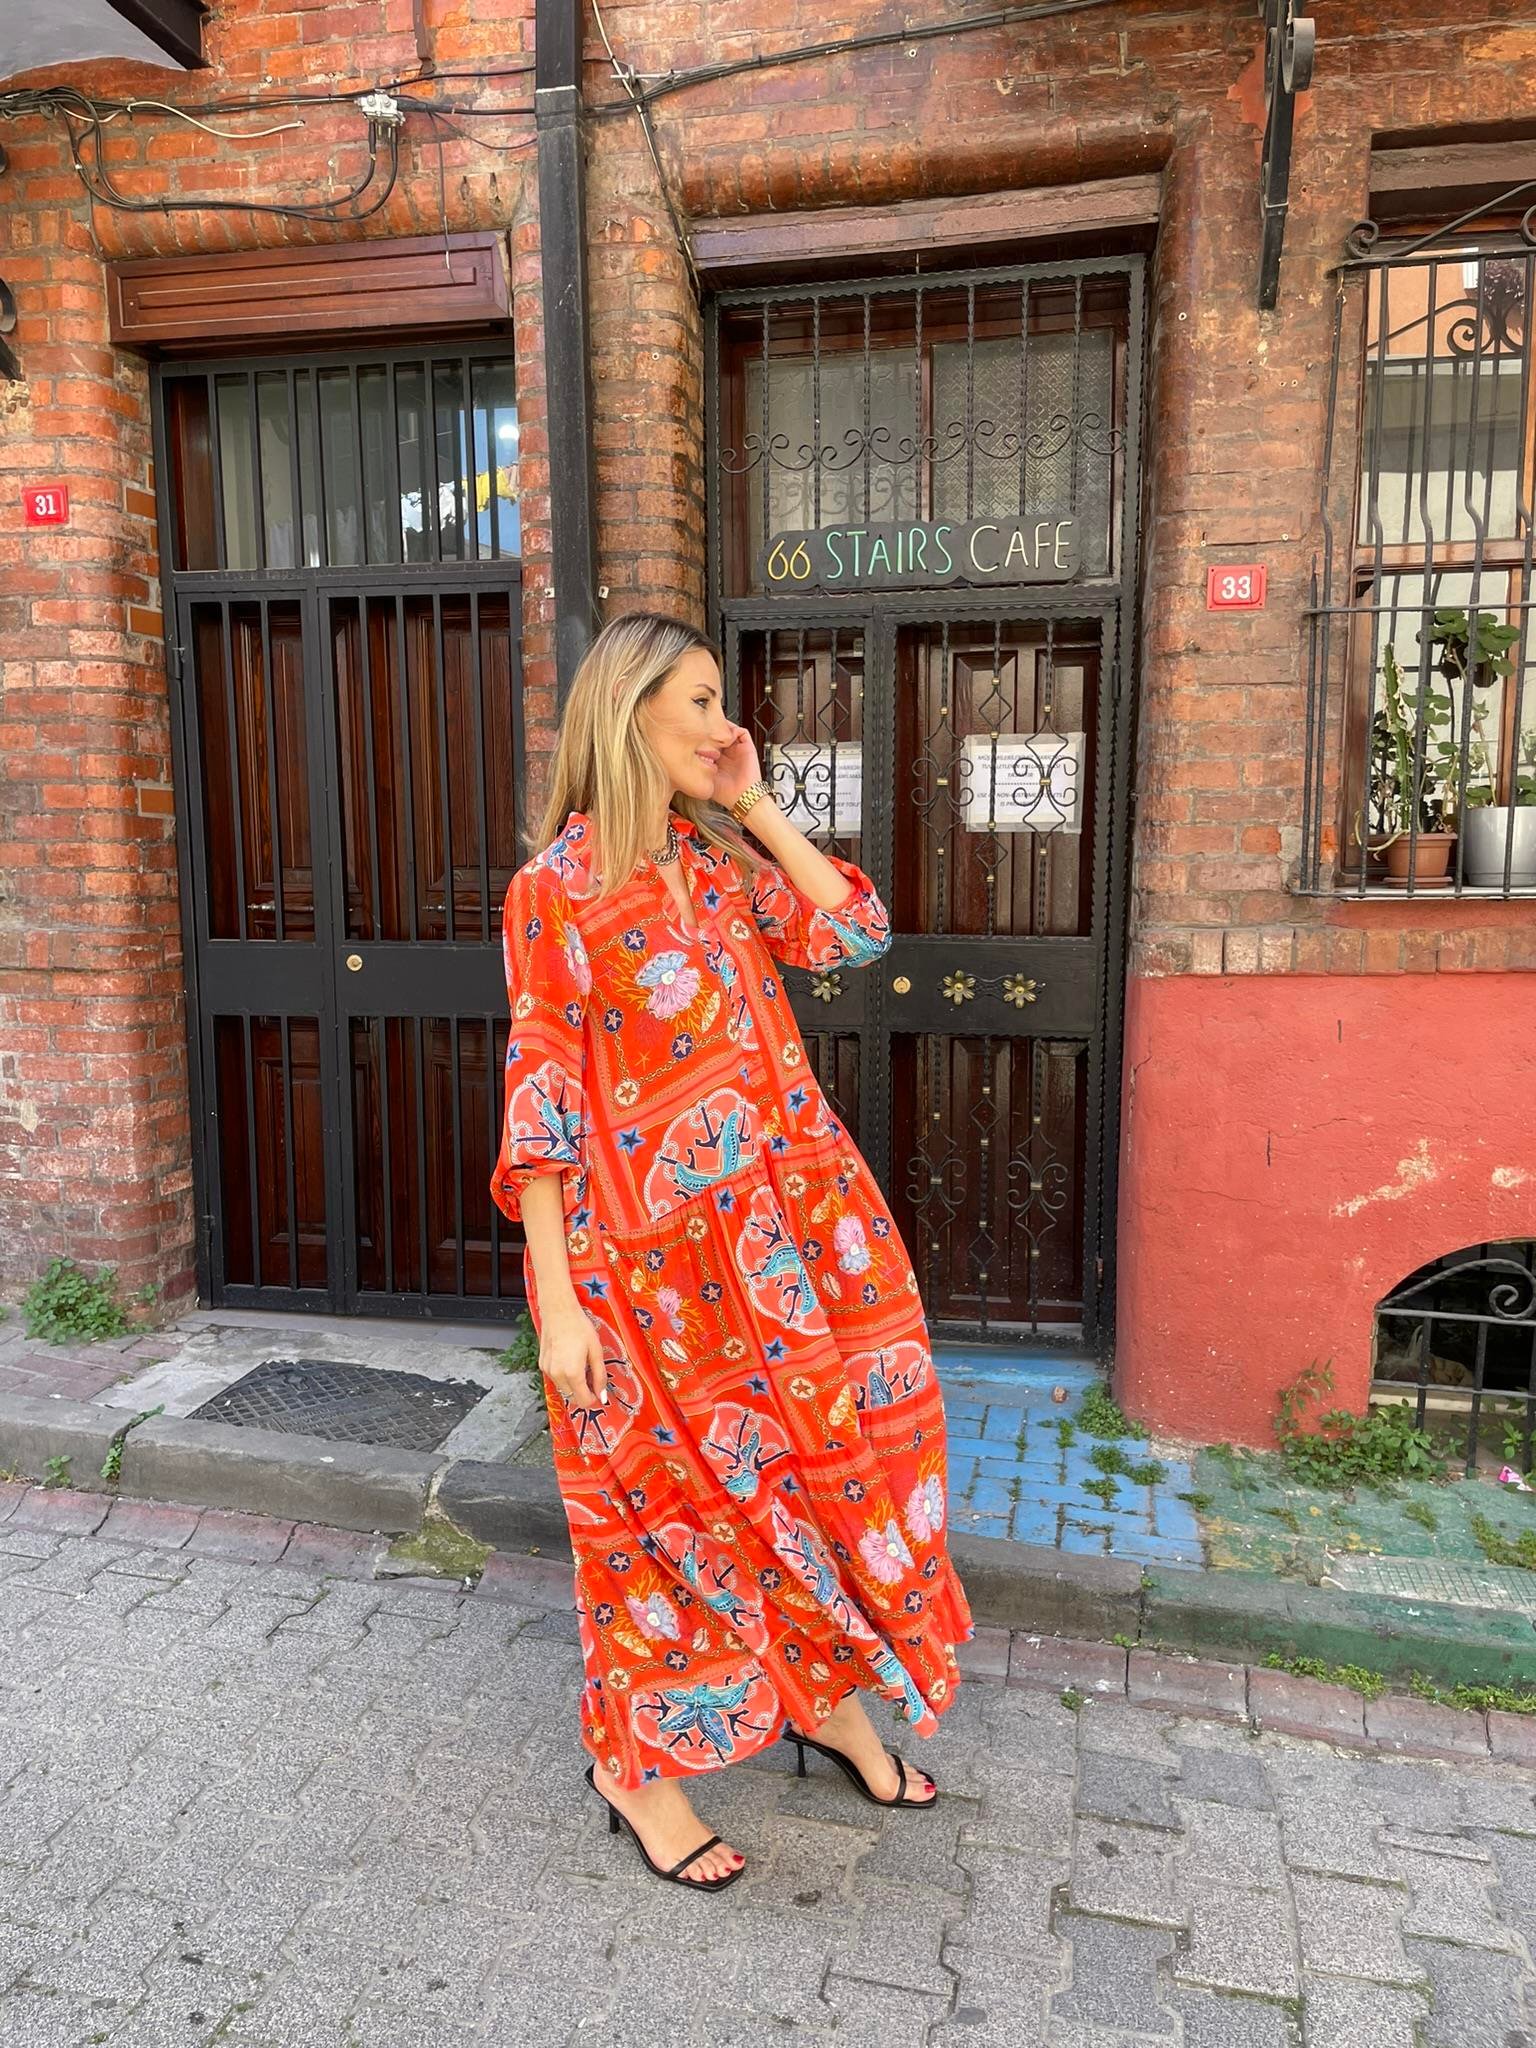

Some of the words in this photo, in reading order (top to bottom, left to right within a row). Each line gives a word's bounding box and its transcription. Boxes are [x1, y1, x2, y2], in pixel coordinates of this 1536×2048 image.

[35, 494, 57, 516] 31
[767, 539, 811, 580] 66
[825, 525, 952, 580] STAIRS
[969, 520, 1073, 573] CAFE
[1221, 575, 1251, 600] 33
